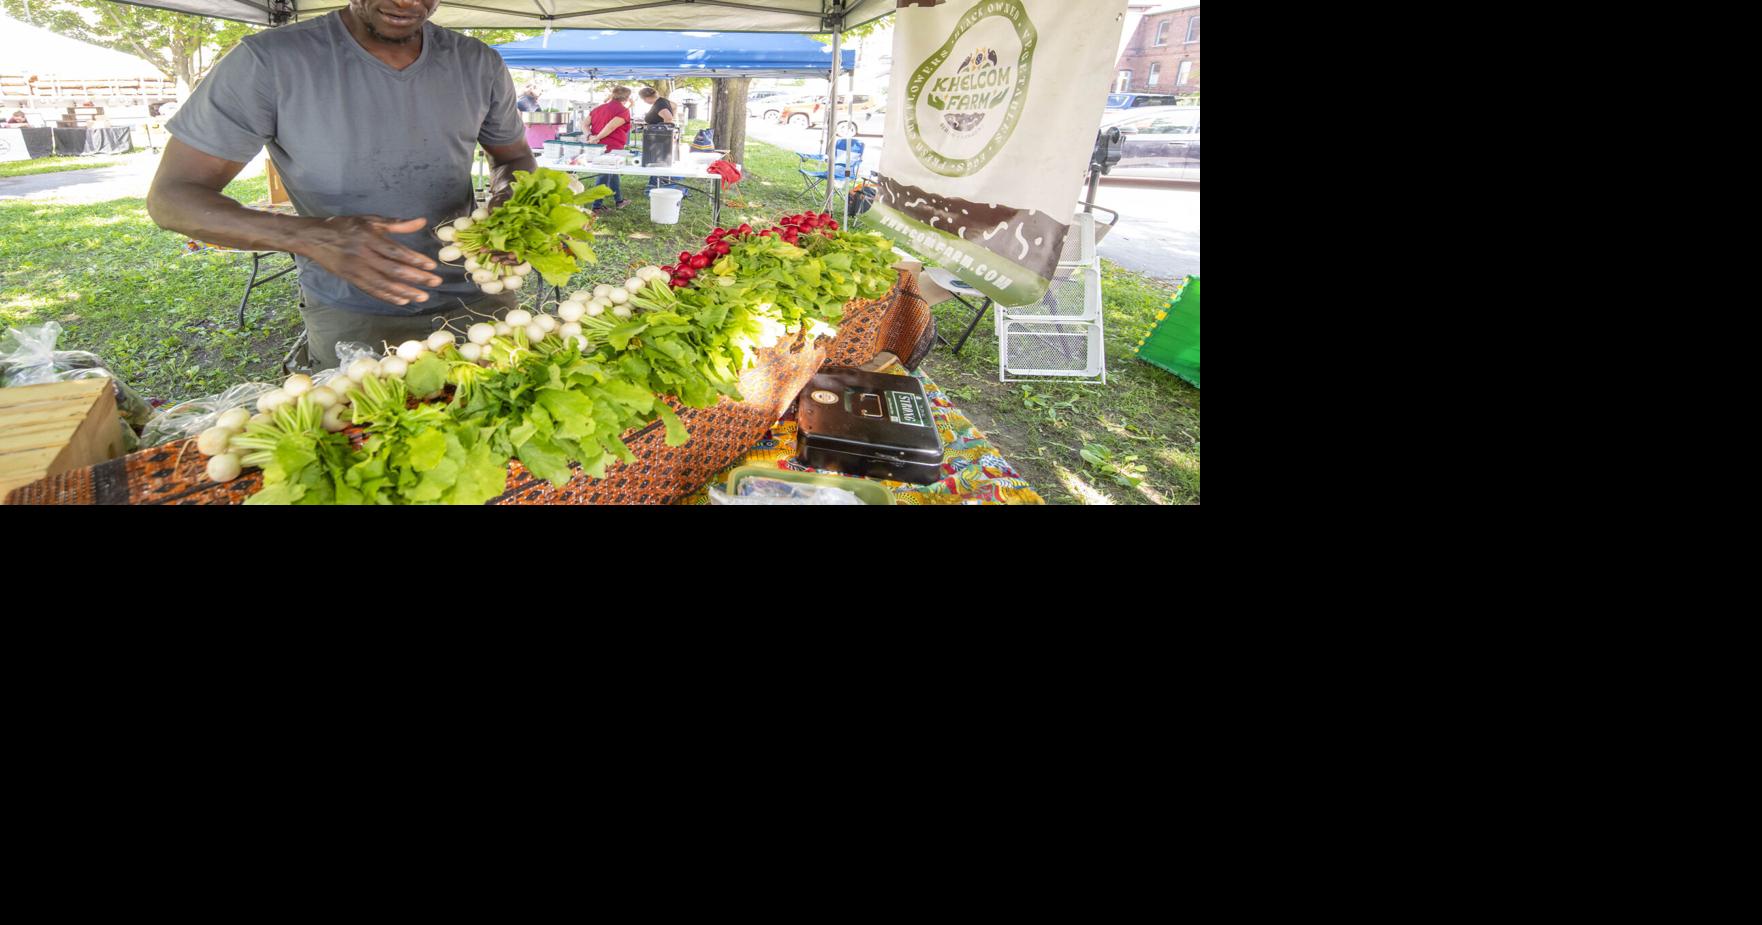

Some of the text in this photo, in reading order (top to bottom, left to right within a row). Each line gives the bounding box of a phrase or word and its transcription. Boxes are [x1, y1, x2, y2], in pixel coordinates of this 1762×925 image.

[988, 2, 1020, 21] OWNED
[931, 66, 1011, 92] KHELCOM
[994, 29, 1033, 144] VEGETABLES
[947, 93, 991, 110] FARM
[899, 395, 916, 422] STRONG
